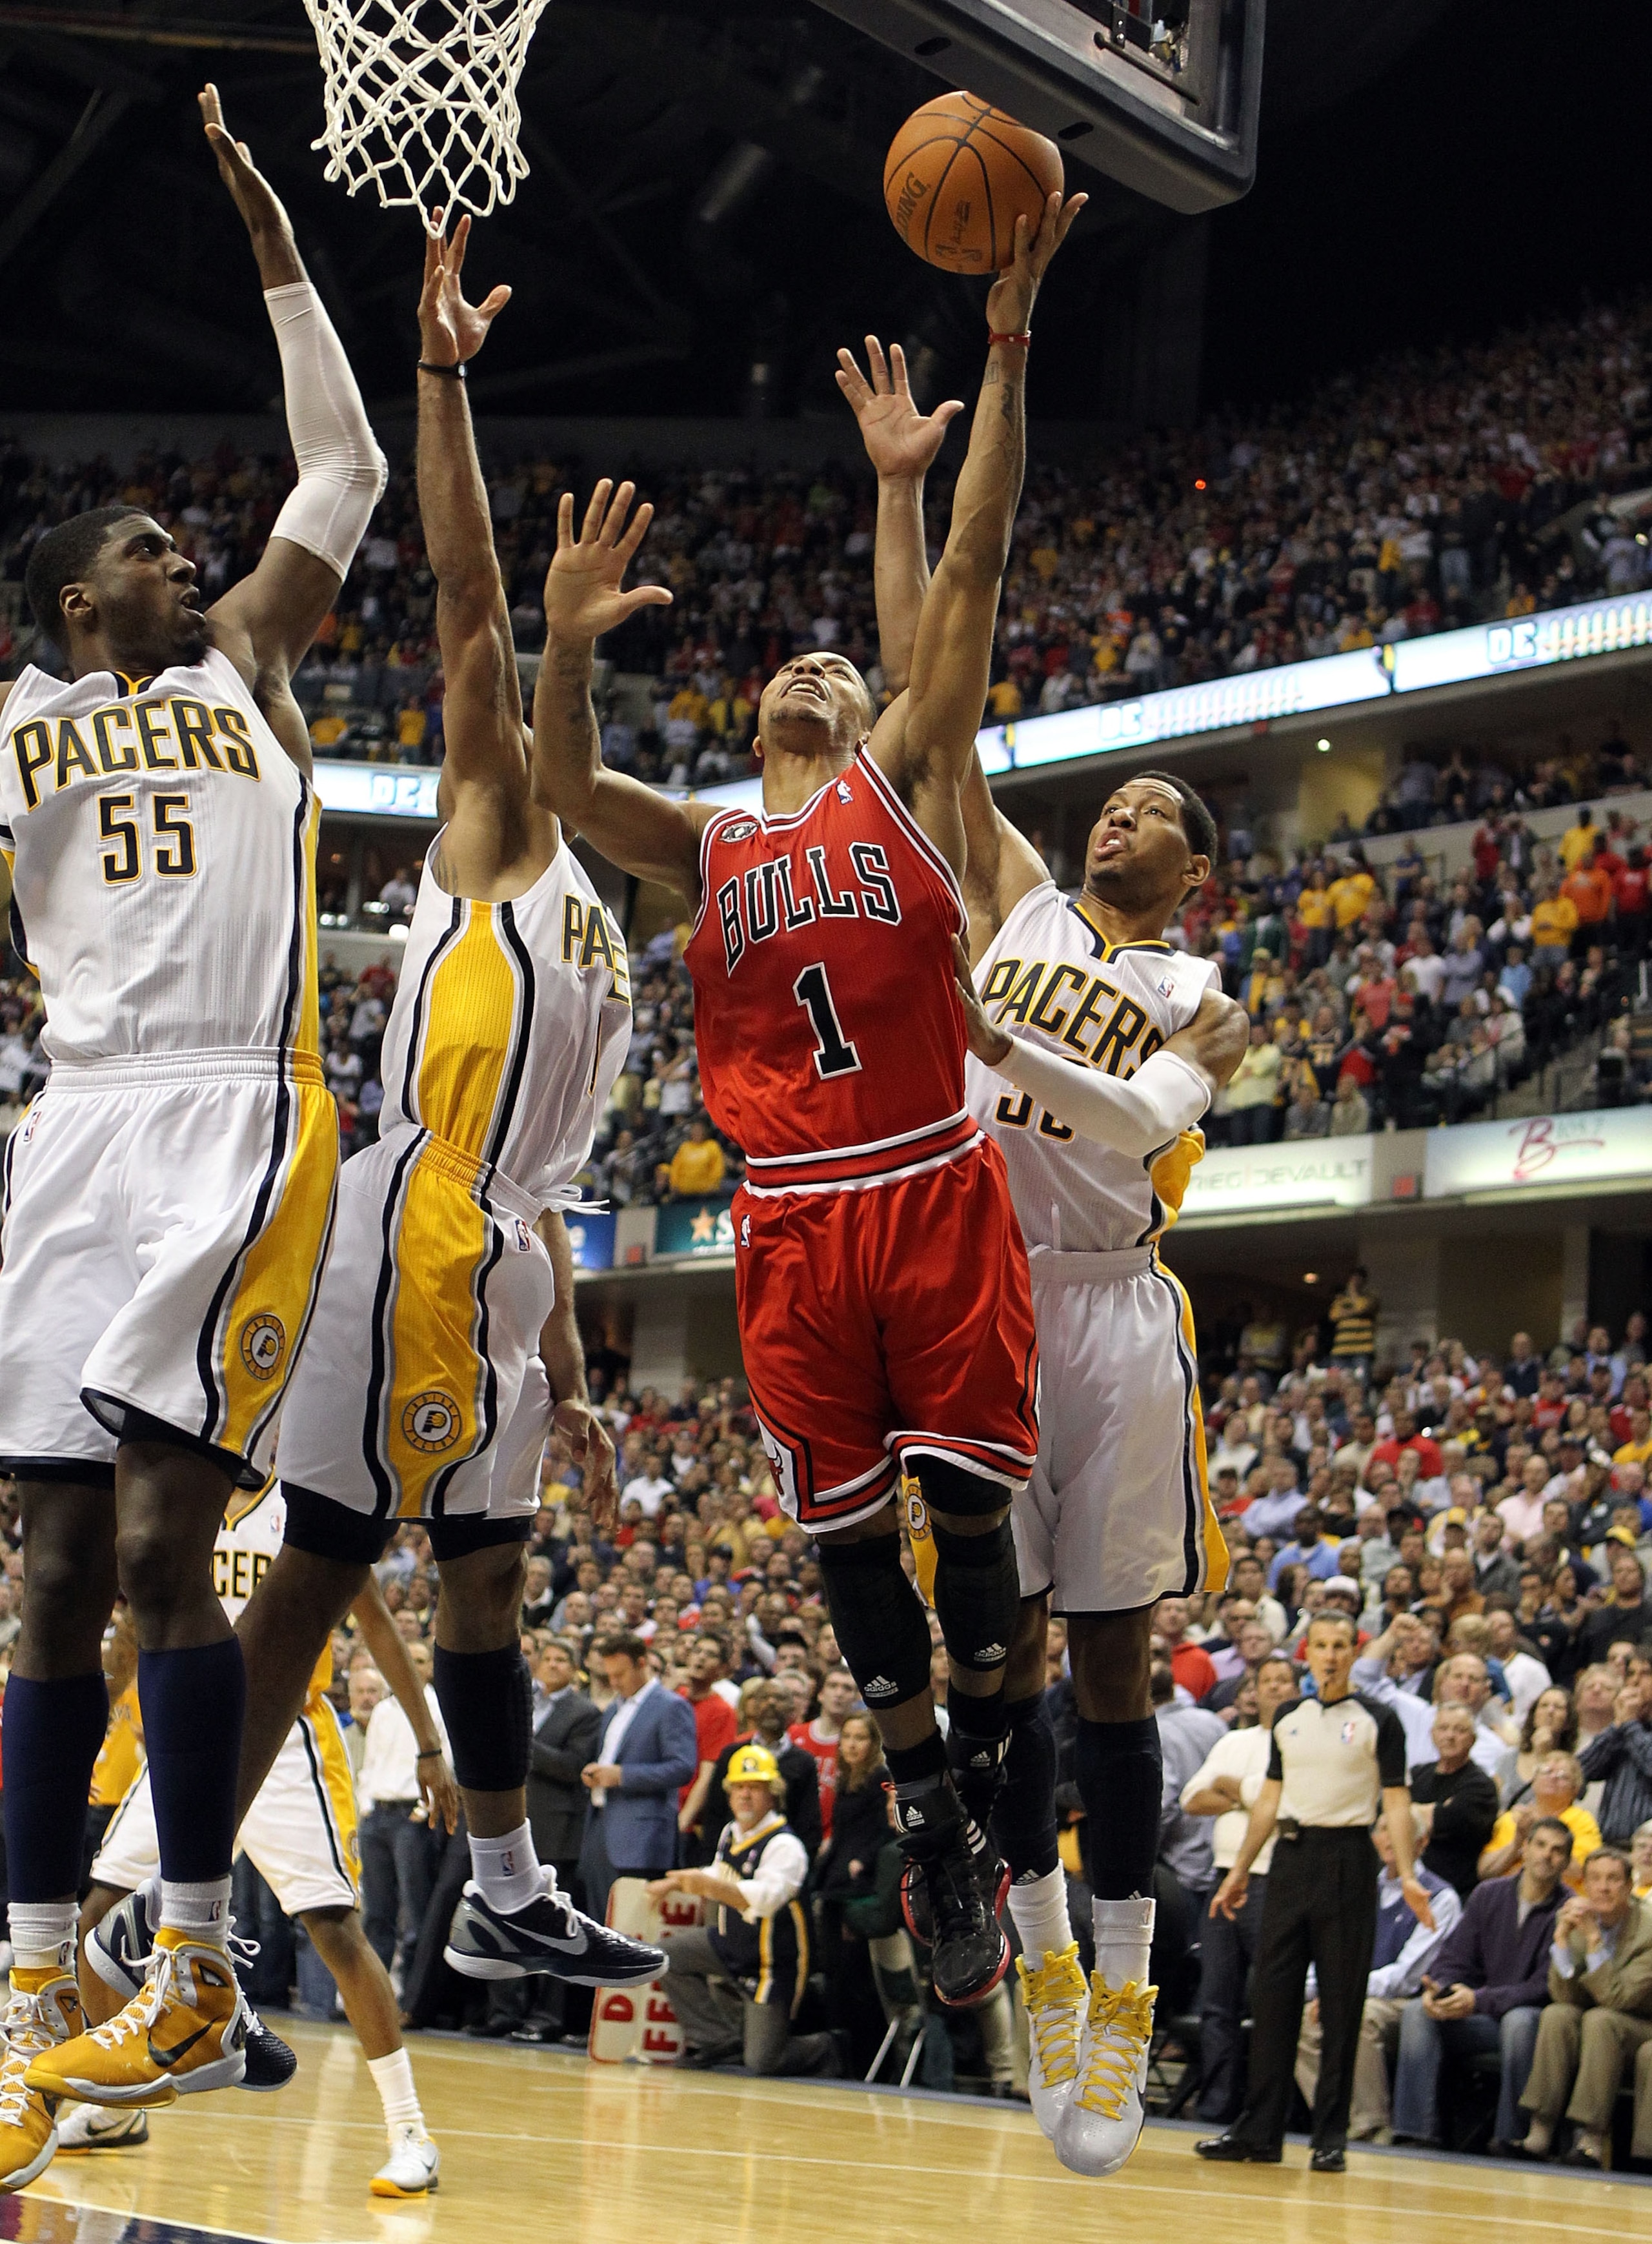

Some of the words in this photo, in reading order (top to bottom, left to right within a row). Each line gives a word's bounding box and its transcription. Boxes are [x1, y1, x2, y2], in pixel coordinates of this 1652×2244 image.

[11, 696, 261, 813] PACERS
[97, 793, 197, 884] 55
[716, 841, 903, 978] BULLS
[792, 961, 863, 1080] 1
[214, 1550, 274, 1599] CER
